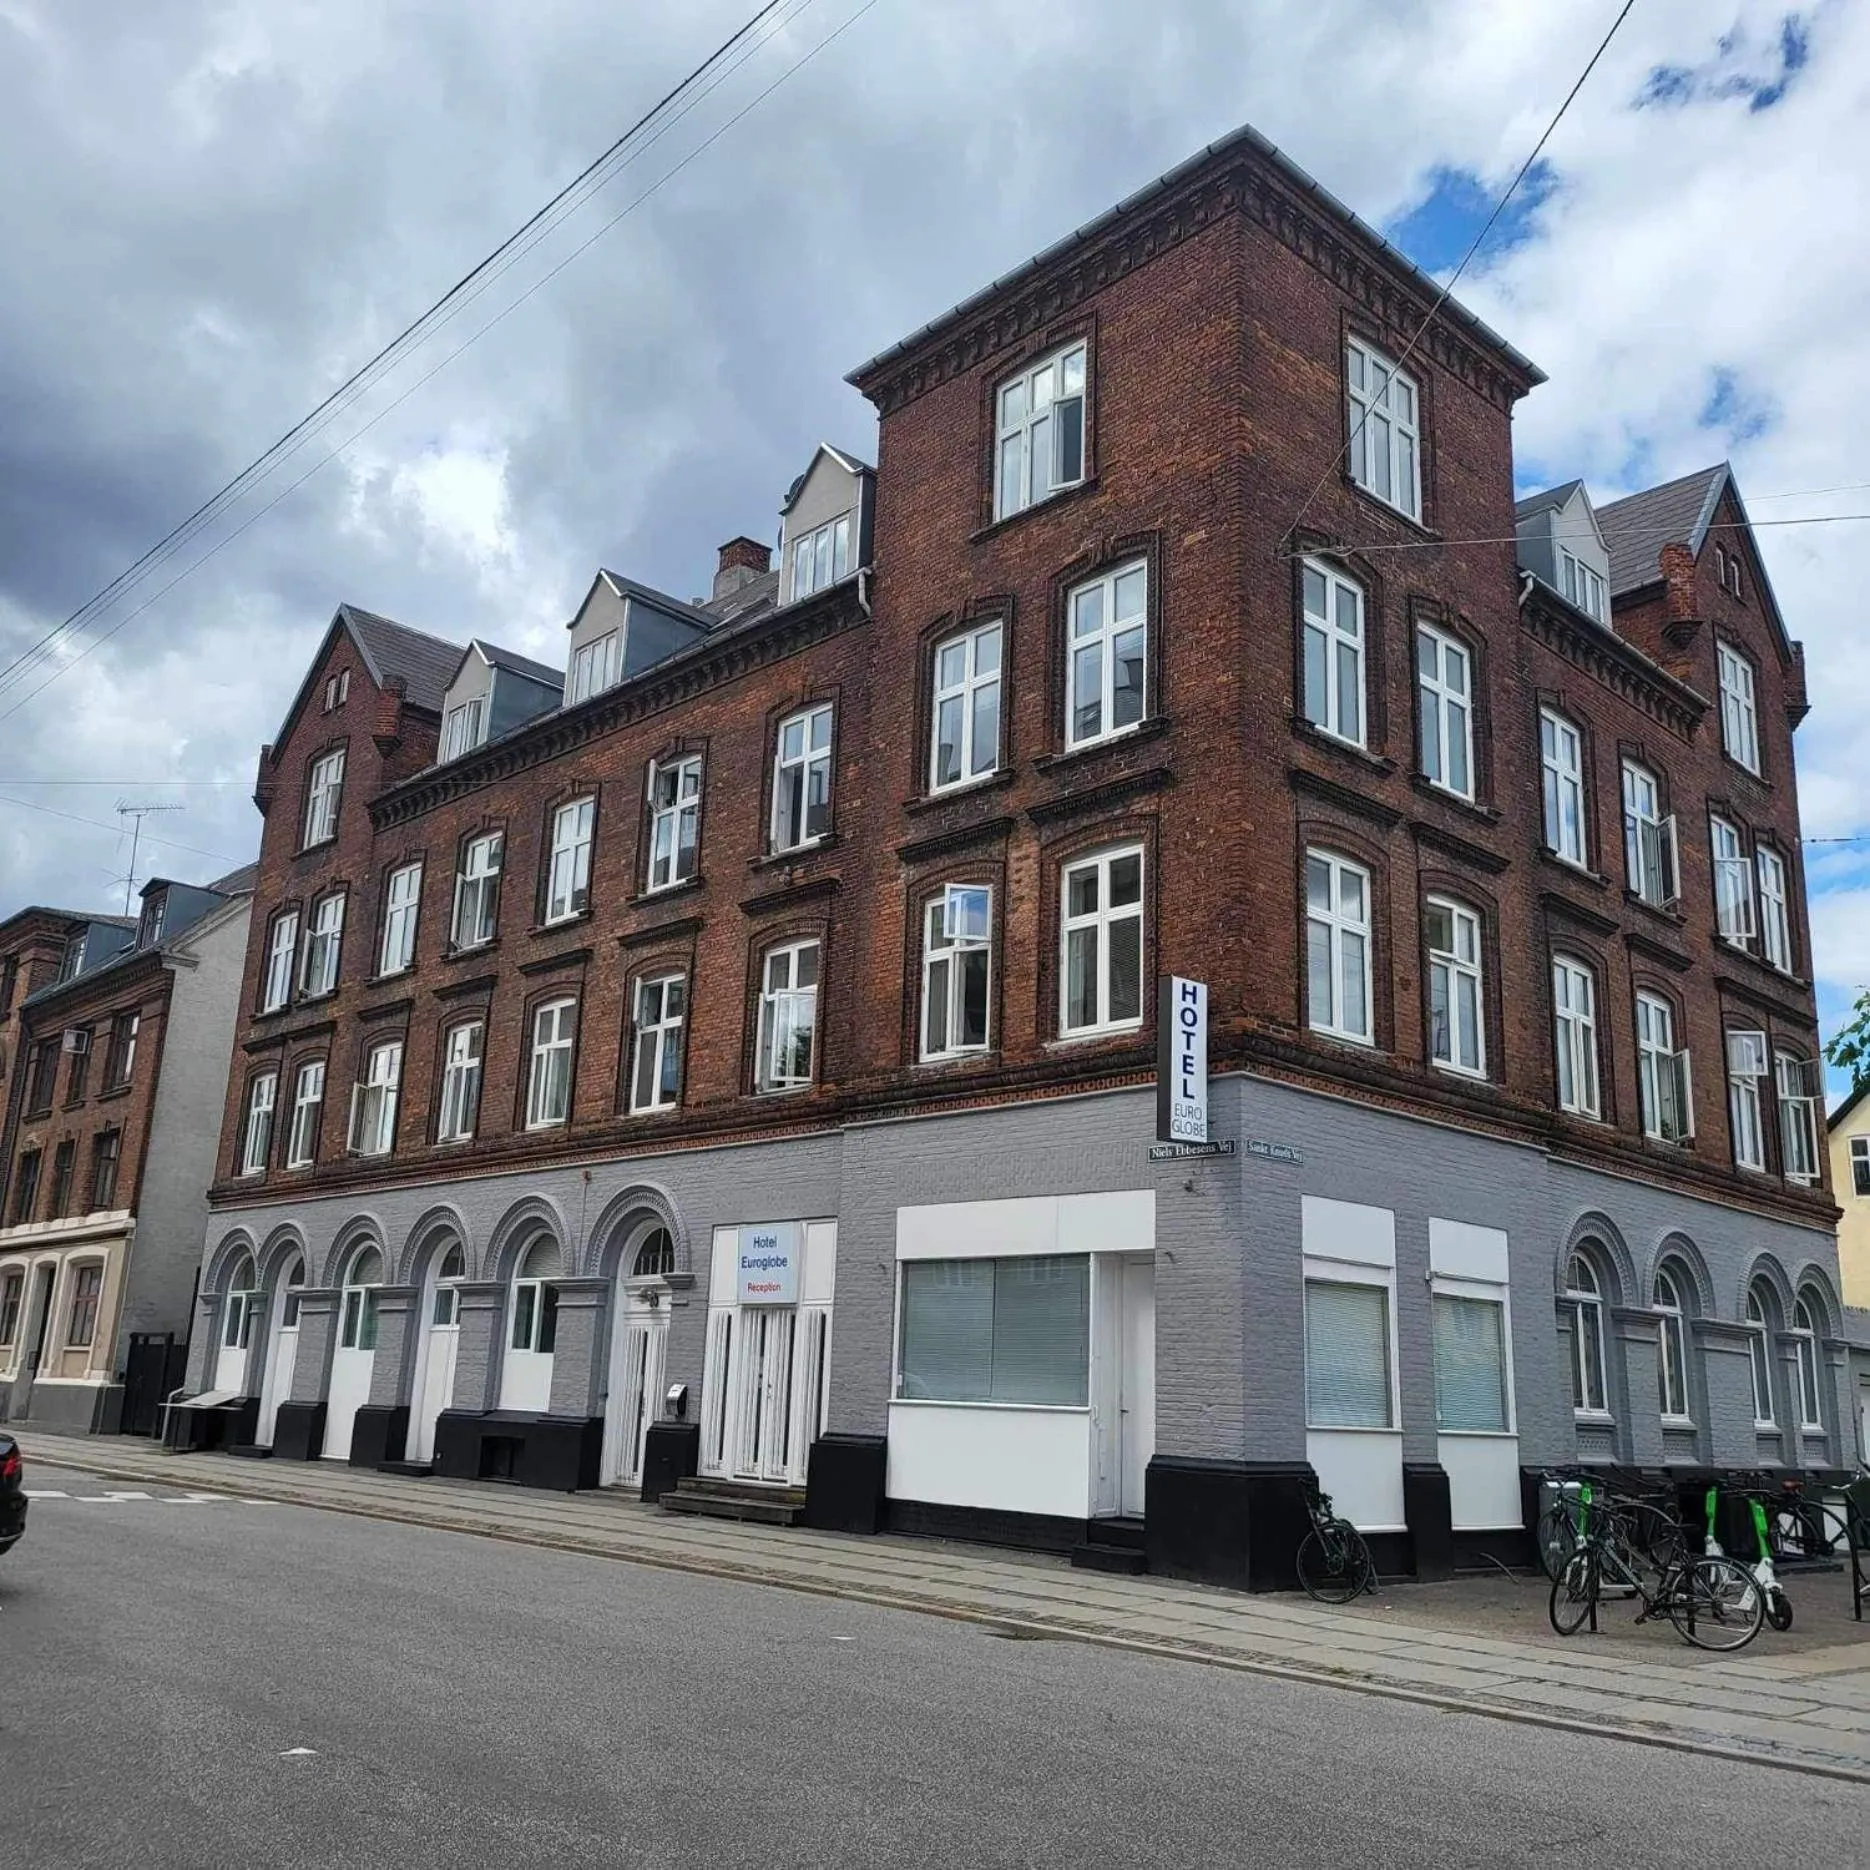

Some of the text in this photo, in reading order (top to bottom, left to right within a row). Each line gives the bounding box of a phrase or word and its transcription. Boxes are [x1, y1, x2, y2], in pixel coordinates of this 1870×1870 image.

[1180, 982, 1198, 1100] HOTEL
[1174, 1102, 1203, 1121] EURO
[1171, 1118, 1206, 1138] GLOBE
[1152, 1147, 1173, 1159] Niels
[752, 1235, 778, 1249] Hotel
[740, 1255, 788, 1271] Euroglobe
[746, 1281, 782, 1294] Reception
